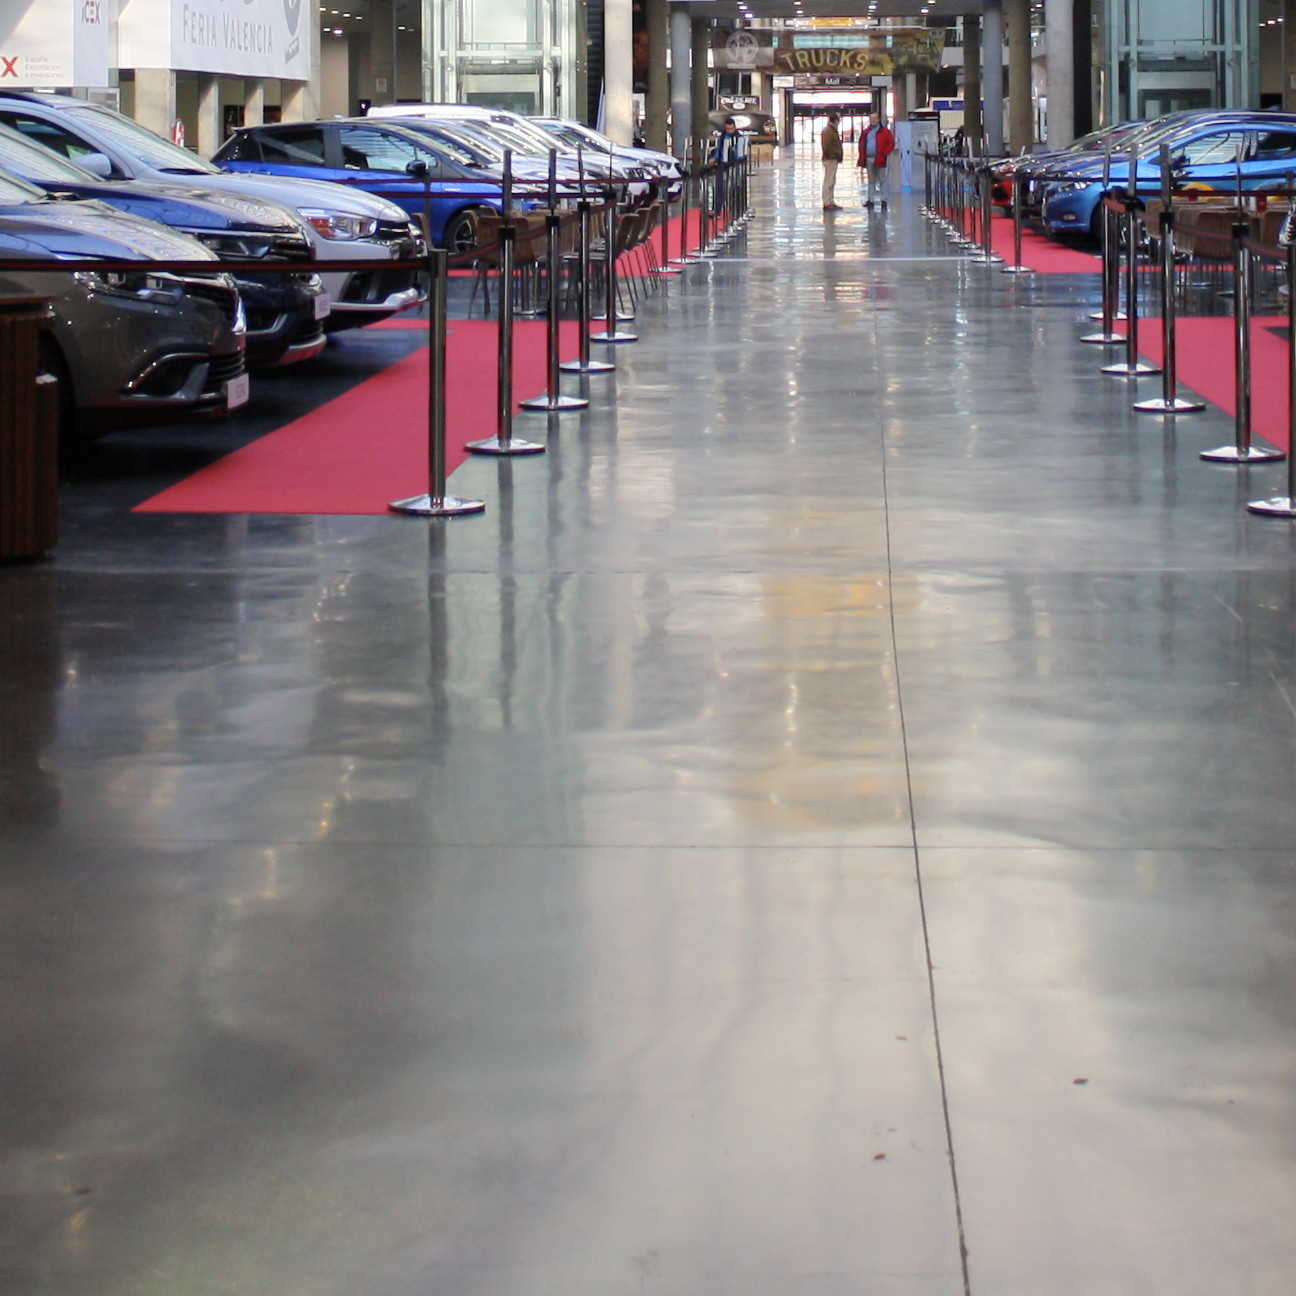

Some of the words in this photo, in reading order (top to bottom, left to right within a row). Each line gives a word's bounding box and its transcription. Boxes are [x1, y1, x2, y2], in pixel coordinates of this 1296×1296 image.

[184, 3, 216, 46] FERIA
[222, 11, 272, 56] VALENCIA
[782, 48, 869, 72] TRUCKS
